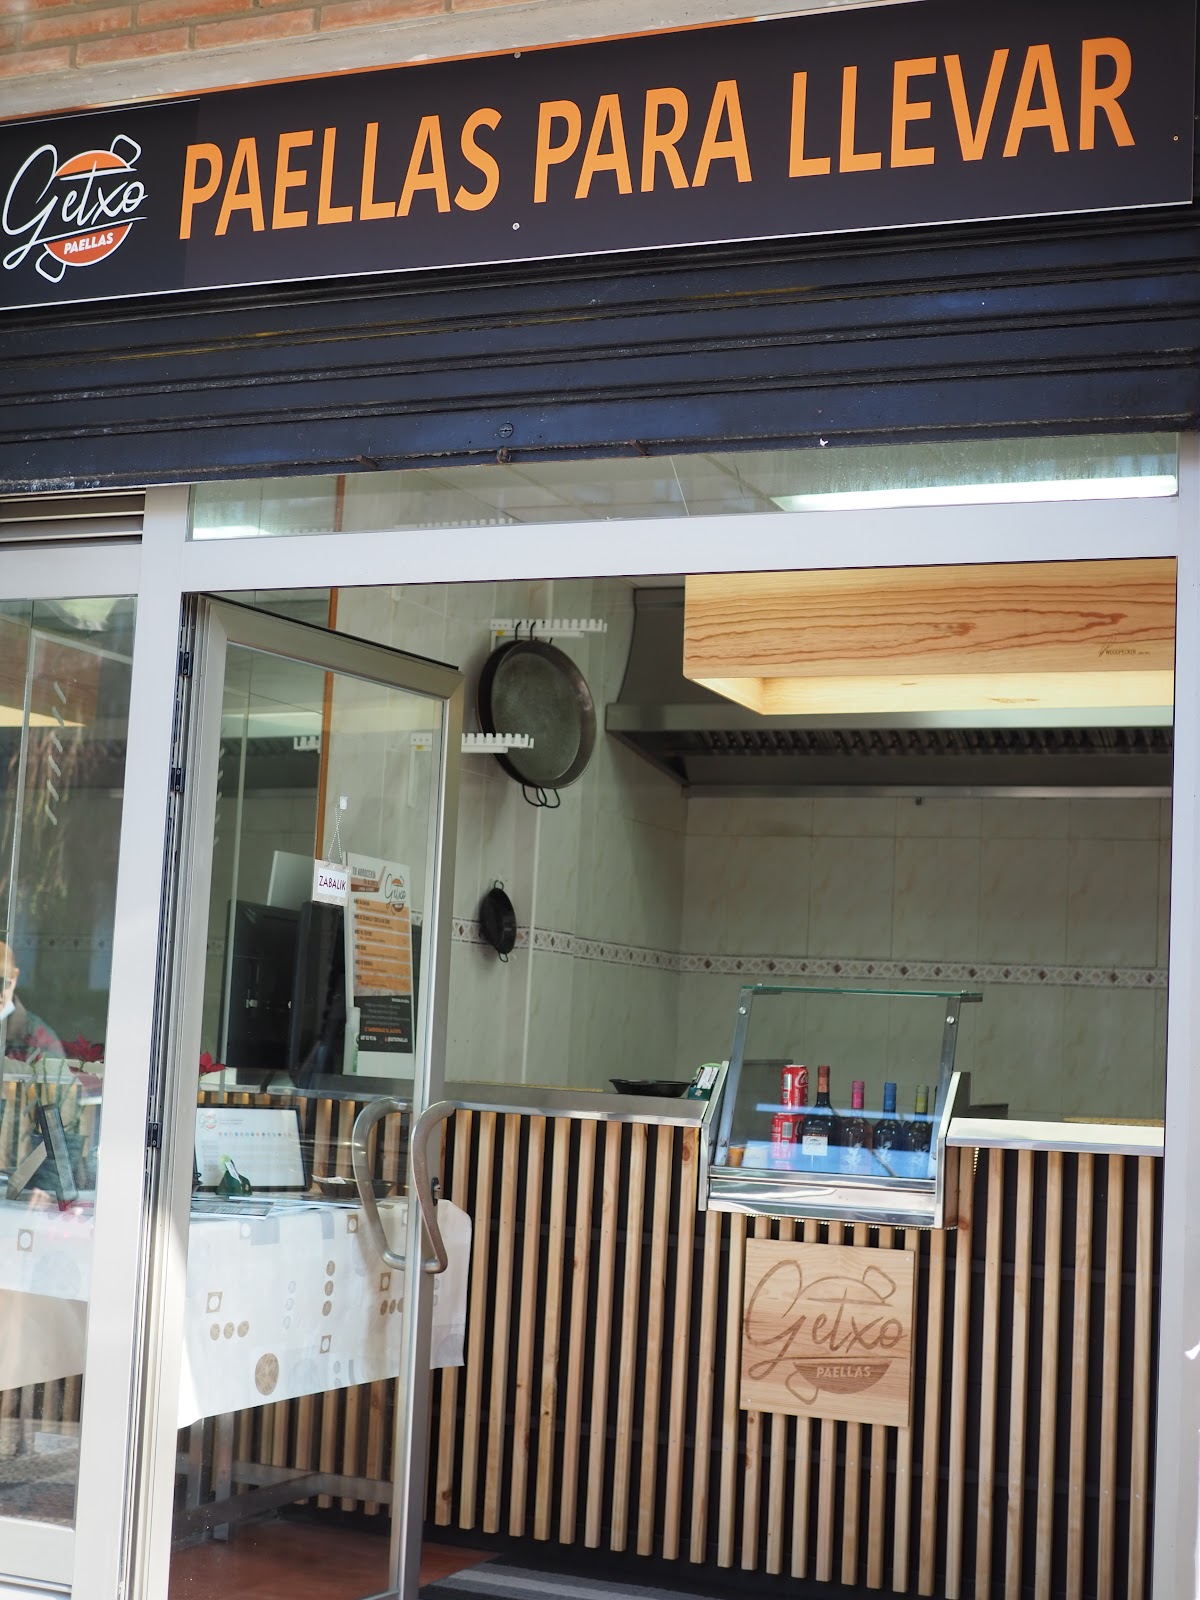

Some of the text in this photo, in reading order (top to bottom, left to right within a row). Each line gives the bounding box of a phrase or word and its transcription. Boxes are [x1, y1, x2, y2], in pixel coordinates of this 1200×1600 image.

[179, 37, 1135, 240] PAELLAS PARA LLEVAR
[2, 144, 148, 270] Getxo
[63, 232, 114, 255] PAELLAS
[319, 875, 346, 891] ZABALIK
[745, 1259, 908, 1380] Getxo
[815, 1365, 872, 1379] PAELLAS
